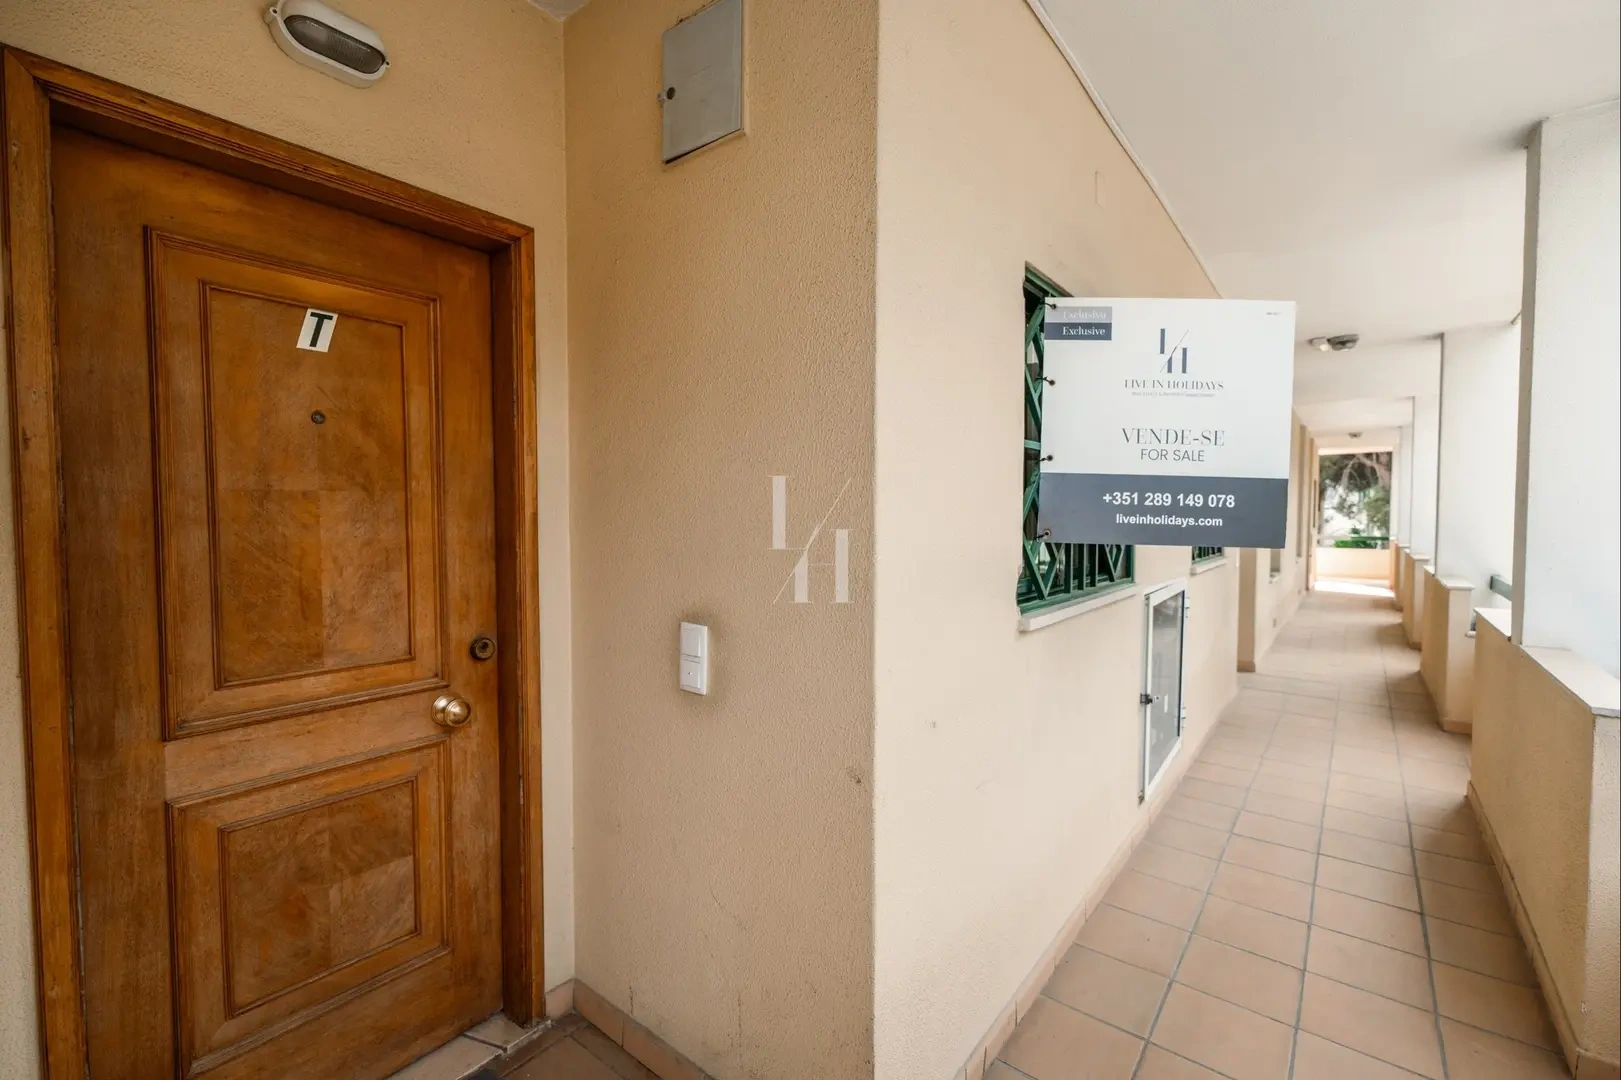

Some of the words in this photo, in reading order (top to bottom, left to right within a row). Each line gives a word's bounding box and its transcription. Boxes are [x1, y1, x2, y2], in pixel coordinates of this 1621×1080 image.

[310, 311, 334, 348] T
[1062, 325, 1106, 336] Exclusive
[1124, 379, 1149, 389] LIVE
[1152, 379, 1165, 389] IN
[1167, 380, 1224, 391] HOLIDAYS
[1121, 427, 1225, 447] VENDE-SE
[1140, 448, 1169, 461] FOR
[1172, 449, 1205, 462] SALE
[1102, 491, 1139, 506] +351
[1144, 492, 1172, 507] 289
[1176, 493, 1204, 508] 149
[1207, 494, 1236, 508] 078
[1115, 513, 1223, 528] liveinholidays.com
